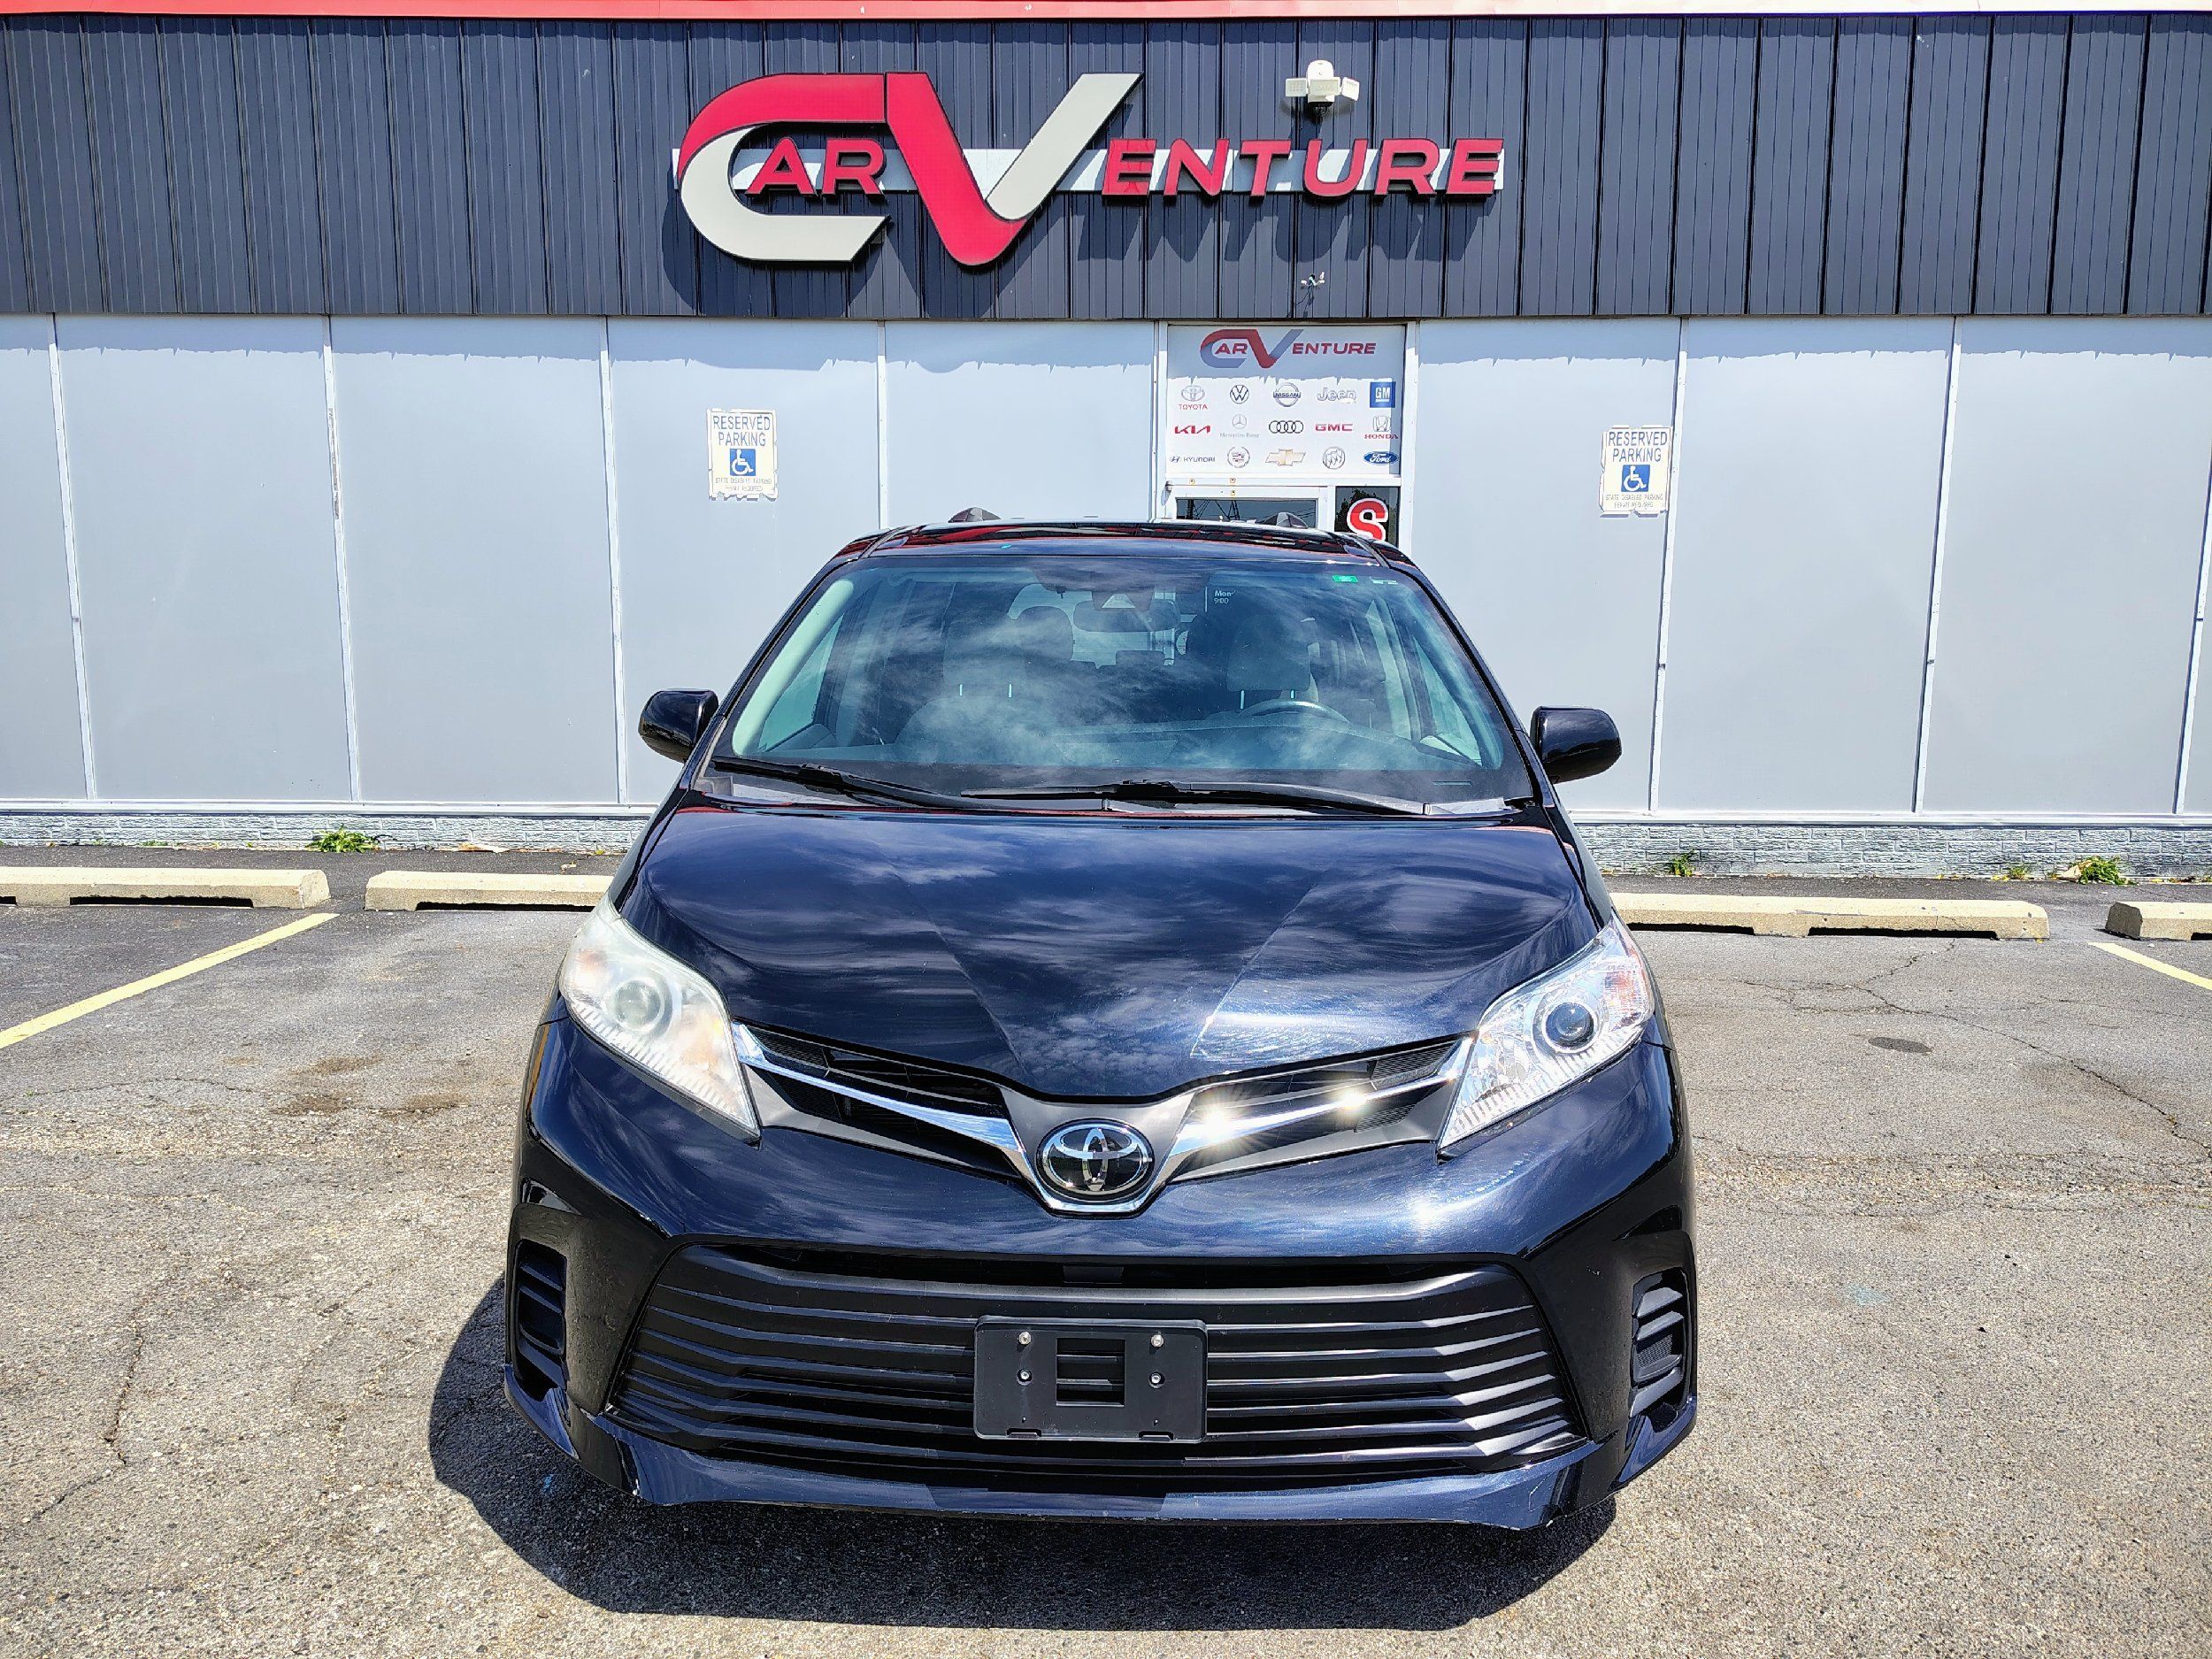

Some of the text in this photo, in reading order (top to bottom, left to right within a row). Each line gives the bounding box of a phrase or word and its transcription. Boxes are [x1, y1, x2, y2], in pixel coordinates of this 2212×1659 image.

[1375, 387, 1391, 399] GM
[712, 415, 772, 431] RESERVED
[1174, 425, 1211, 434] KIA
[1315, 423, 1354, 432] GMC
[718, 431, 767, 447] PARKING
[1608, 431, 1668, 446] RESERVED
[1369, 453, 1392, 464] Ford
[1612, 447, 1662, 463] PARKING
